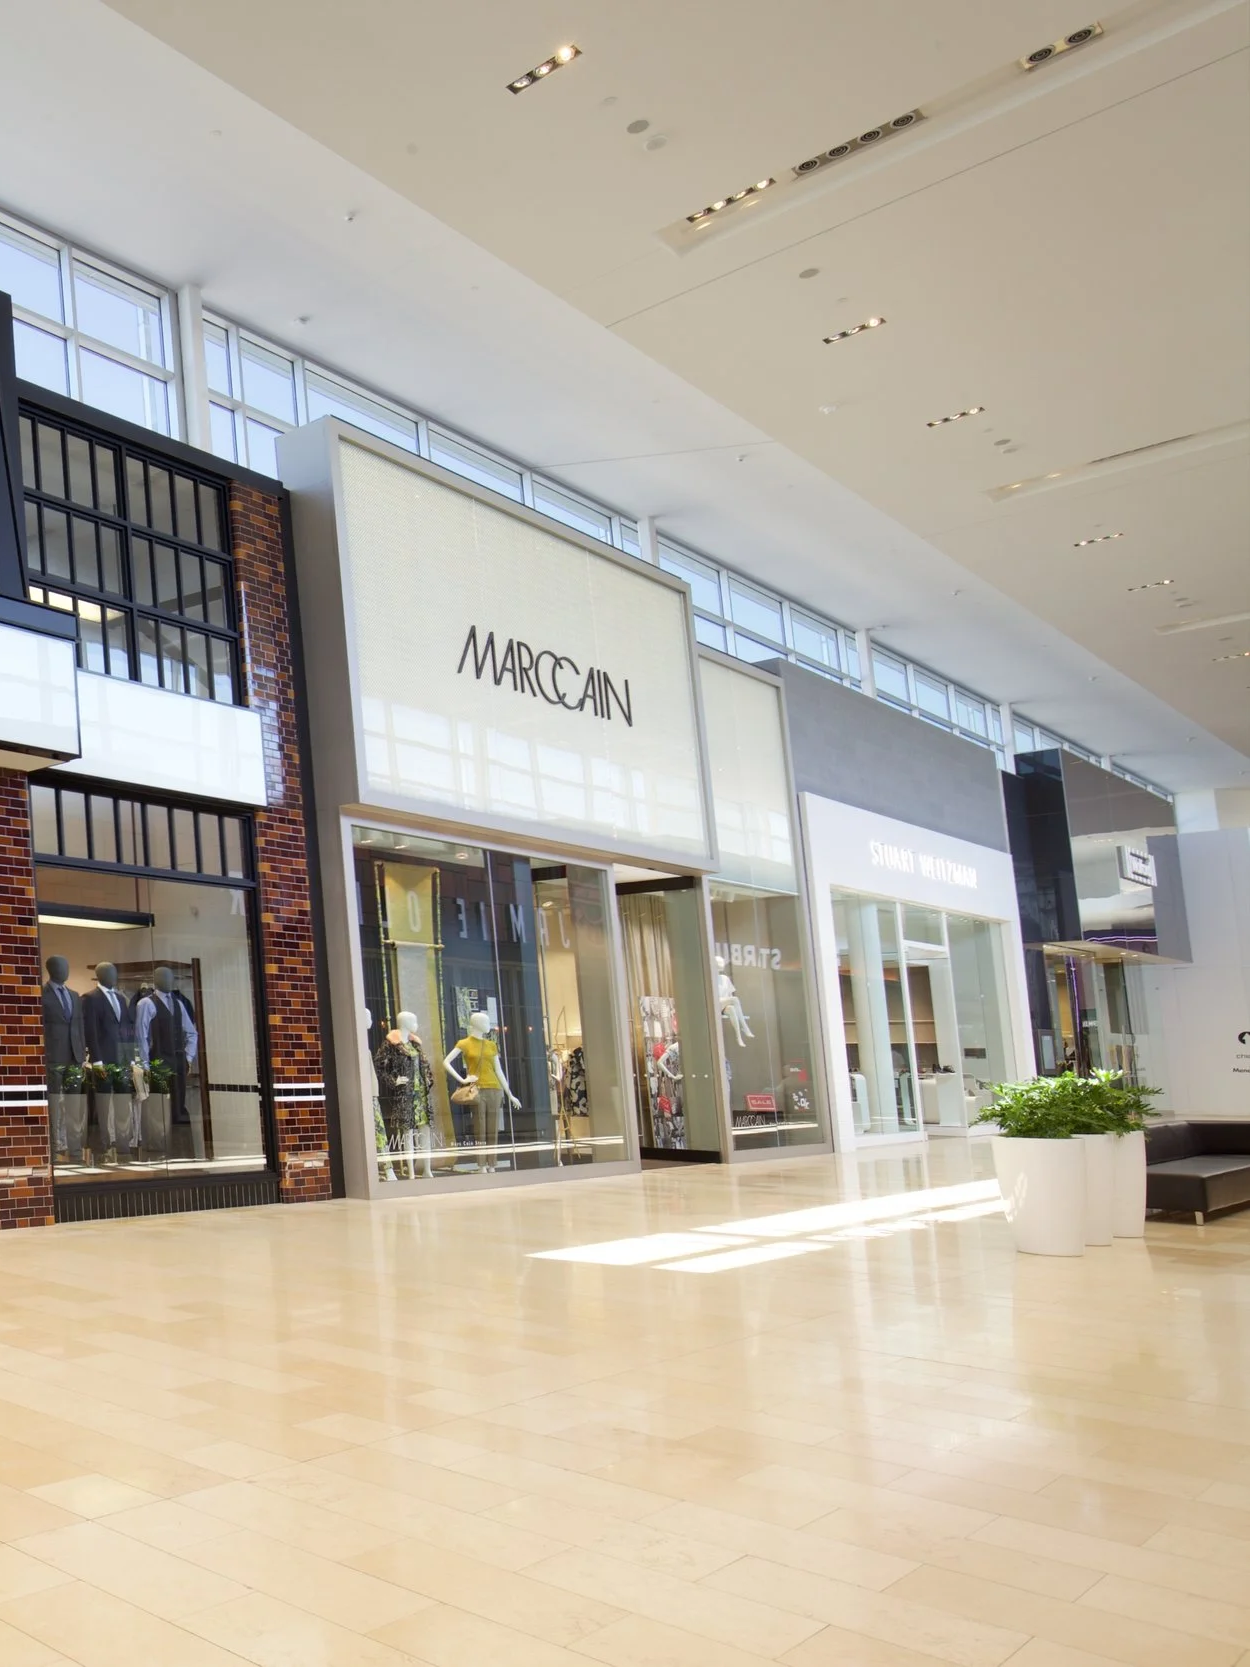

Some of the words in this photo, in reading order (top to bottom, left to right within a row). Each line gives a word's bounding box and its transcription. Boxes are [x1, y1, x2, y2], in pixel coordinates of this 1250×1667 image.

[457, 625, 633, 728] MARCCAIN
[869, 839, 915, 874] STUART
[919, 852, 978, 889] WEITZMAN
[388, 1132, 443, 1152] MARCCIN
